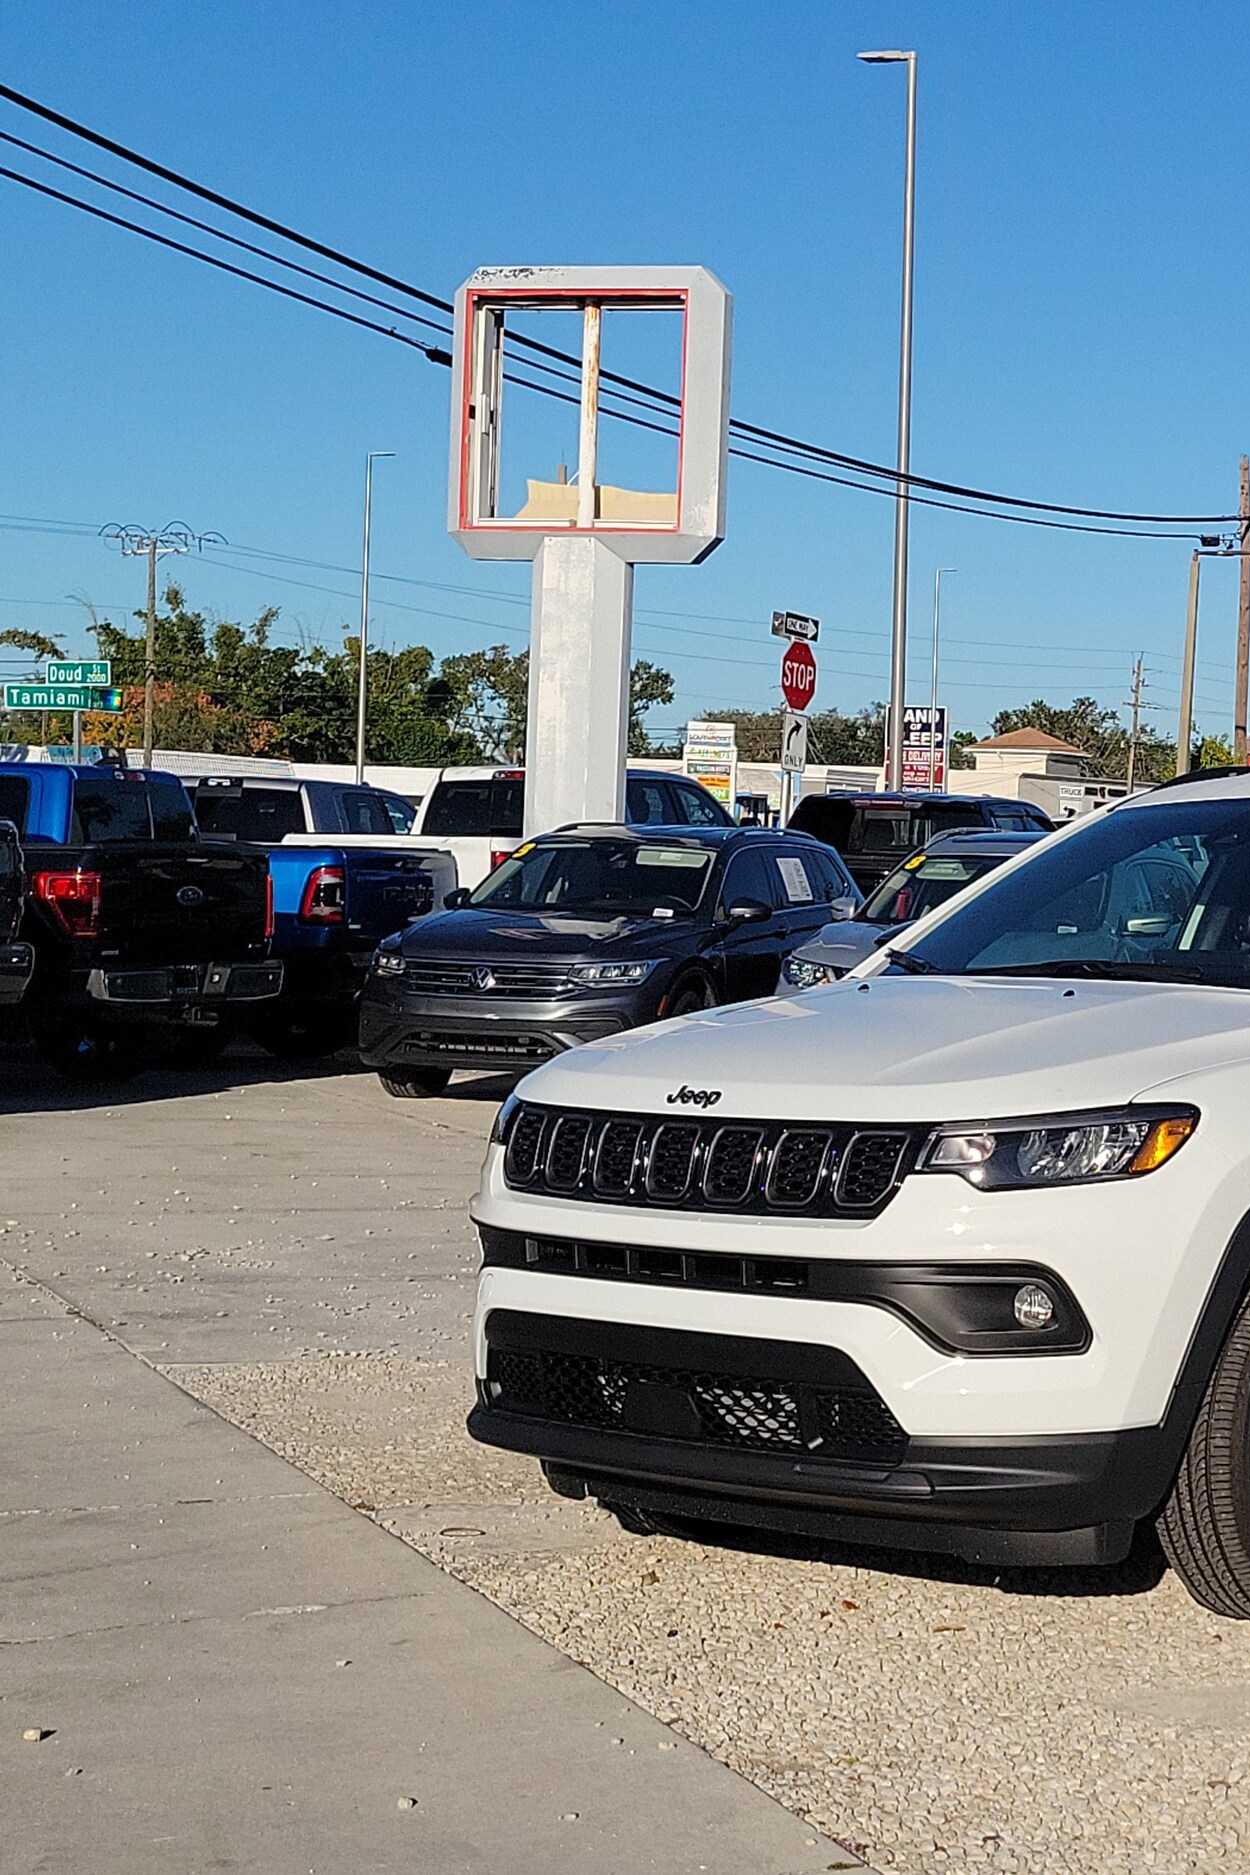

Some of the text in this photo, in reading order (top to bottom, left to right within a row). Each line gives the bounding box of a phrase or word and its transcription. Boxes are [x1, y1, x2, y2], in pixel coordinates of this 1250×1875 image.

[50, 666, 82, 681] Doud
[783, 660, 815, 691] STOP
[10, 689, 85, 706] Tamiami
[903, 709, 940, 723] AND
[784, 754, 803, 768] ONLY
[666, 1085, 722, 1109] Jeep
